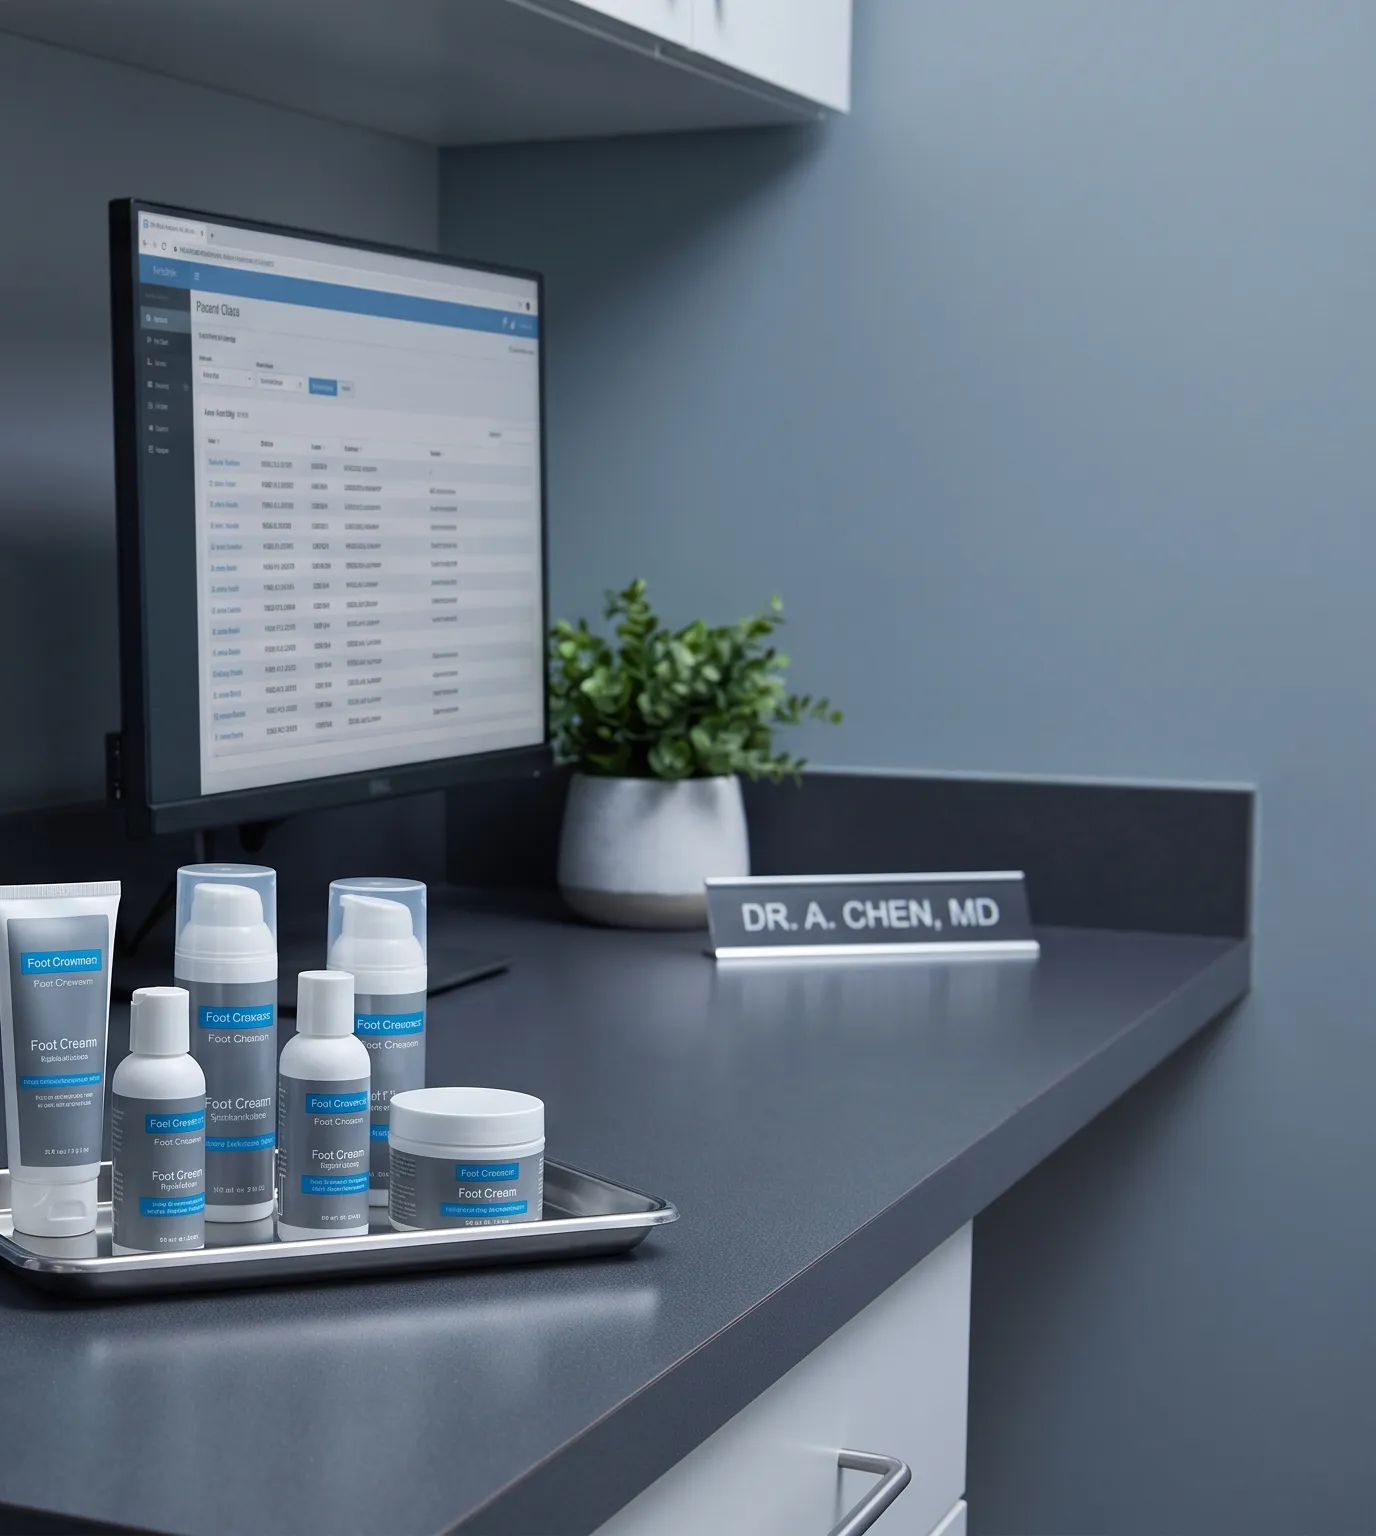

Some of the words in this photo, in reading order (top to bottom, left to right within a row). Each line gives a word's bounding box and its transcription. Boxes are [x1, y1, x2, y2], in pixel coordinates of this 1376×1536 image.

[741, 902, 798, 932] DR.
[804, 901, 836, 930] A.
[842, 898, 942, 931] CHEN,
[948, 897, 1000, 927] MD
[27, 958, 51, 969] Foot
[206, 1011, 231, 1023] Foot
[357, 1019, 381, 1030] Foot
[208, 1034, 231, 1044] Foot
[30, 1039, 58, 1051] Foot
[204, 1097, 232, 1110] Foot
[312, 1149, 334, 1160] Foot
[152, 1170, 175, 1181] Foot
[461, 1169, 479, 1178] Foot
[458, 1188, 482, 1199] Foot
[484, 1187, 517, 1199] Cream
